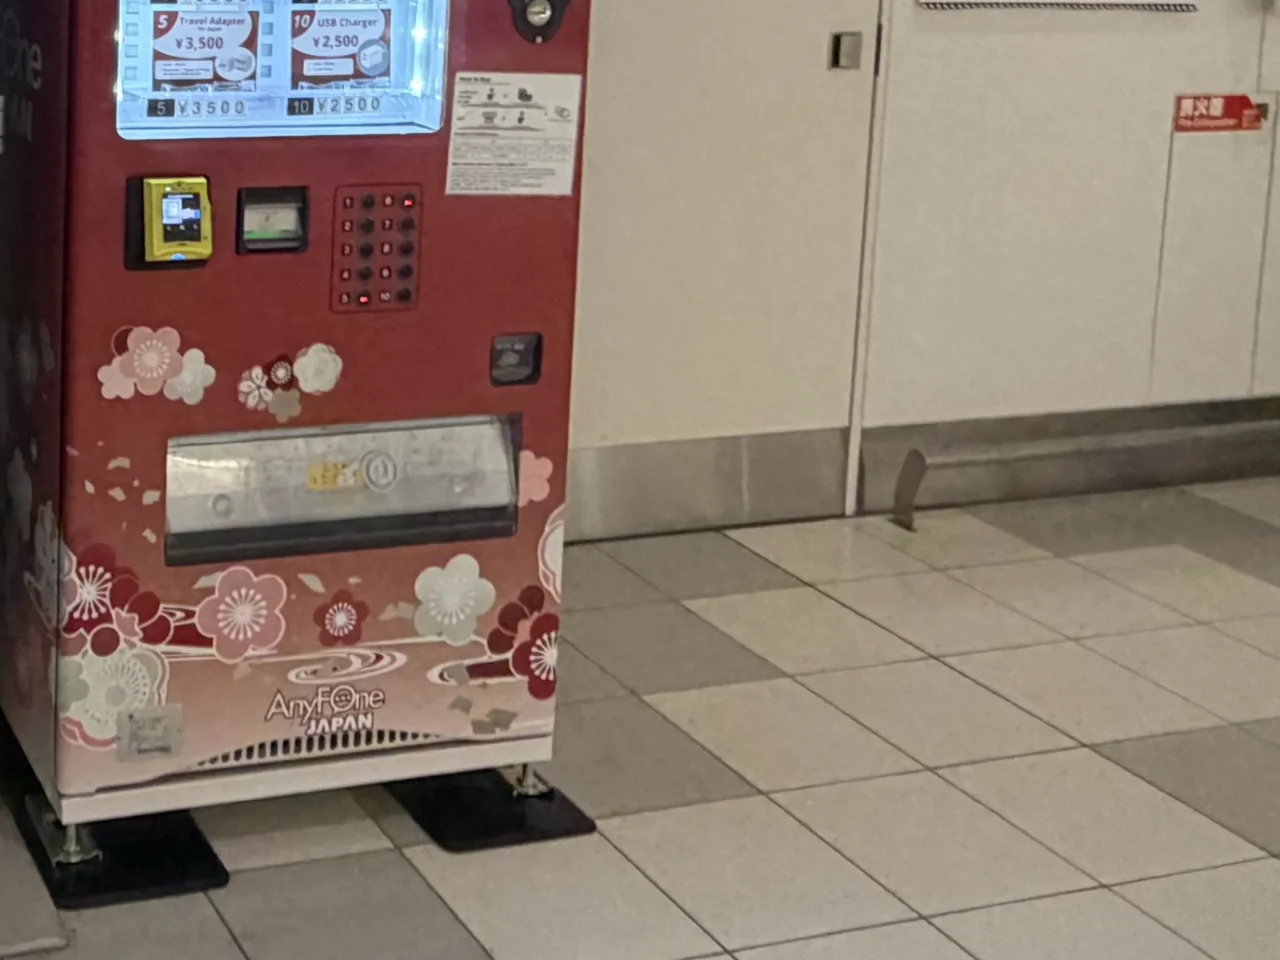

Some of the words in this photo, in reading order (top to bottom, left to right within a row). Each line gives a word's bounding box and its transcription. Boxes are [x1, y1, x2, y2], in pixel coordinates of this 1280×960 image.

[158, 14, 169, 29] 5
[179, 16, 208, 26] Travel
[209, 16, 246, 28] Adapter
[293, 14, 310, 28] 10
[317, 17, 337, 28] USB
[339, 17, 378, 30] Charger
[175, 36, 224, 51] ¥3,500
[312, 35, 359, 51] ¥2,500
[156, 101, 166, 115] 5
[293, 100, 309, 114] 10
[305, 712, 375, 736] JAPAN
